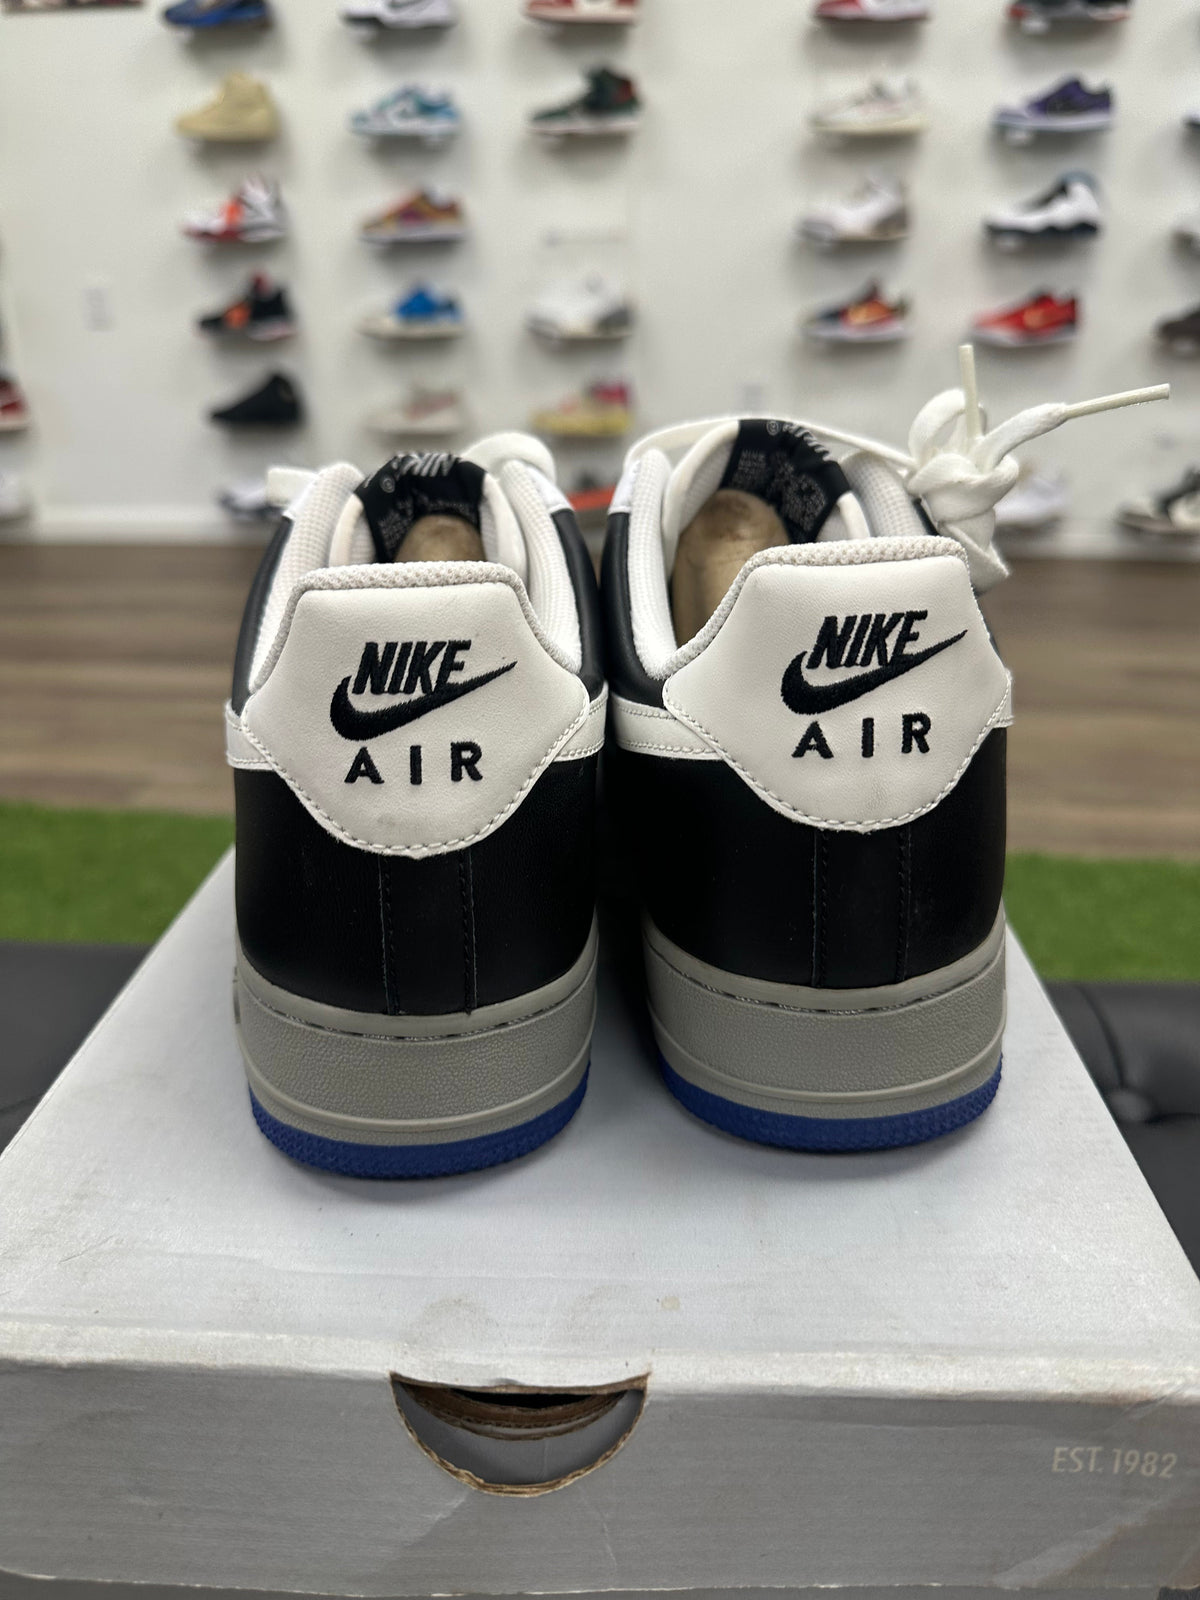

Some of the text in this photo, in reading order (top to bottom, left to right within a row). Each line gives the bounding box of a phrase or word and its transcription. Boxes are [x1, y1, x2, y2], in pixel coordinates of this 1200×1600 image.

[806, 609, 928, 669] NIKE
[352, 639, 472, 695] NIKE
[791, 712, 932, 759] AIR
[344, 741, 483, 785] AIR
[1052, 1446, 1178, 1479] EST. 1982
